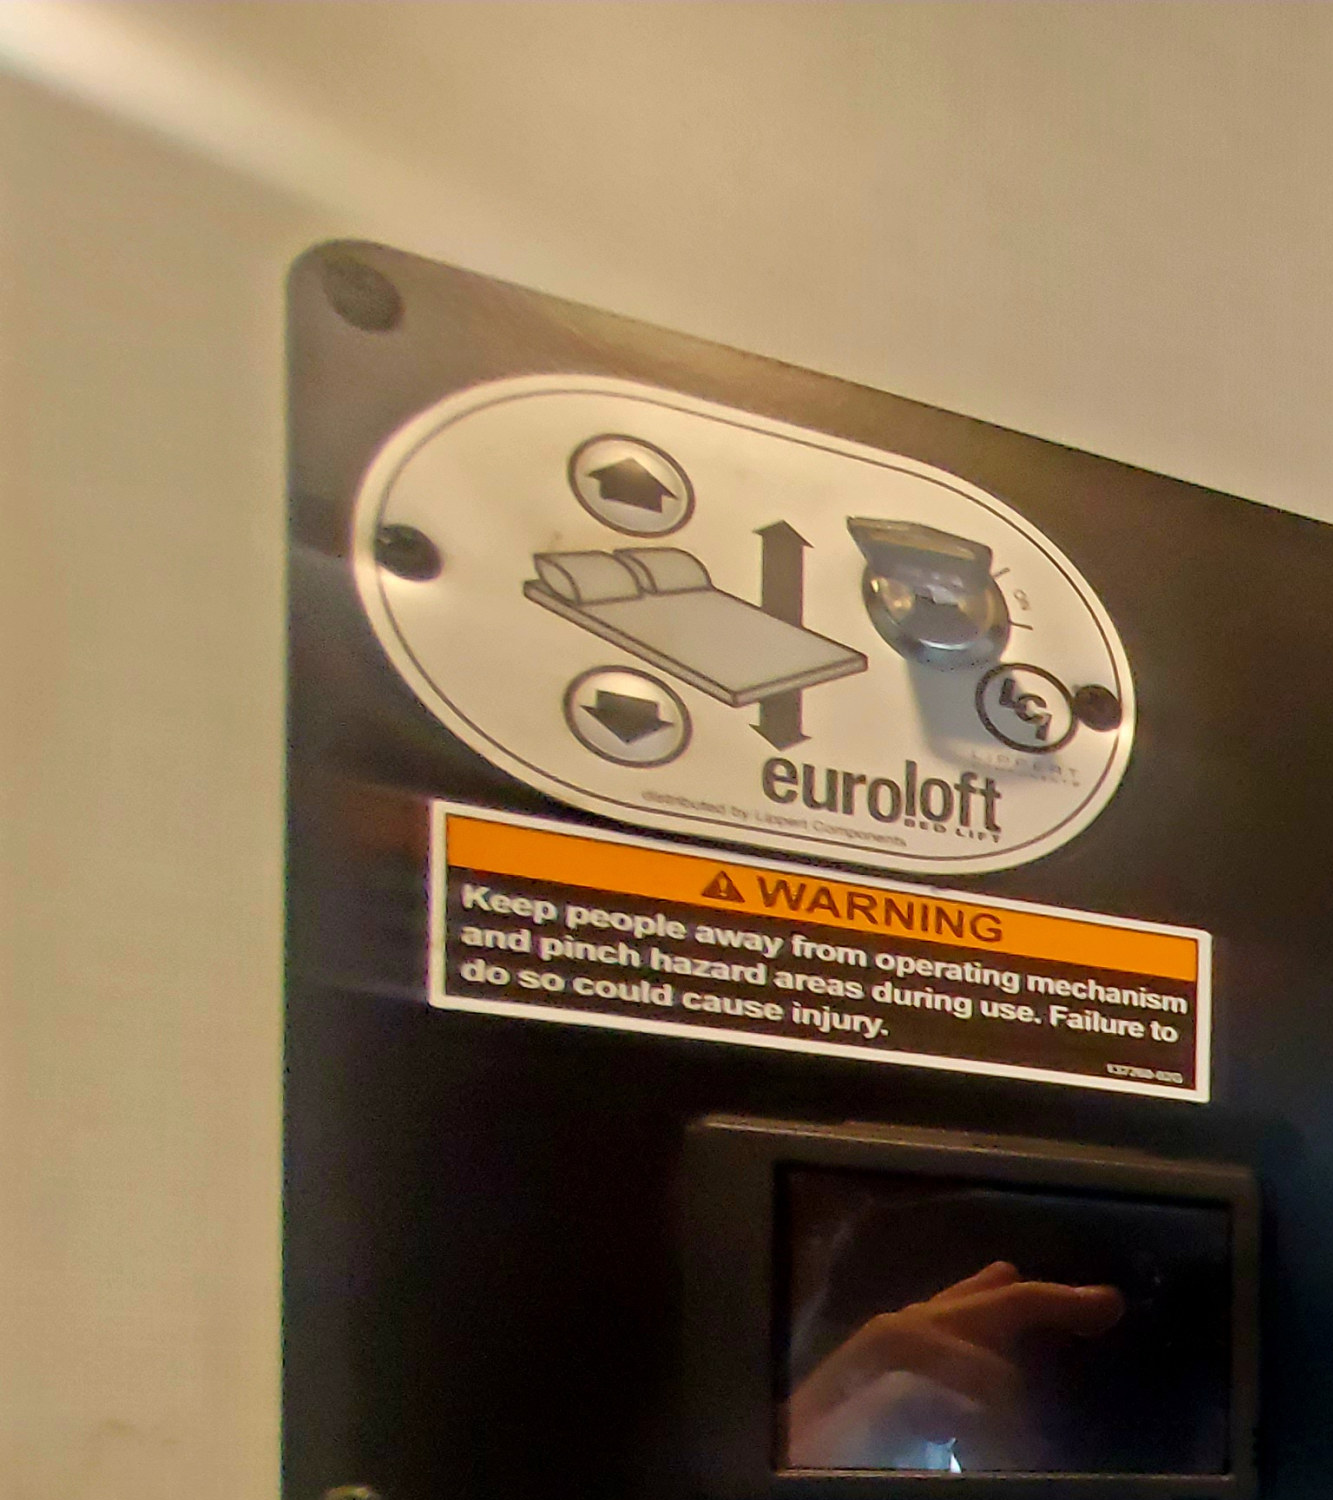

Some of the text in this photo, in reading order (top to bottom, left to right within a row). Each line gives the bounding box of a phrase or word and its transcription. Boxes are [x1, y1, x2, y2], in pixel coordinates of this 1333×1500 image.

[754, 810, 808, 830] Lippert
[811, 822, 907, 848] Components
[761, 756, 1002, 834] euroloft
[904, 817, 1002, 844] BED LIFT
[757, 875, 1004, 943] WARNING
[460, 924, 1179, 1044] and pinch hazard areas during use. Failure to
[461, 882, 1189, 1015] Keep people away from operating mechanism
[460, 957, 889, 1040] do so could cause injury.
